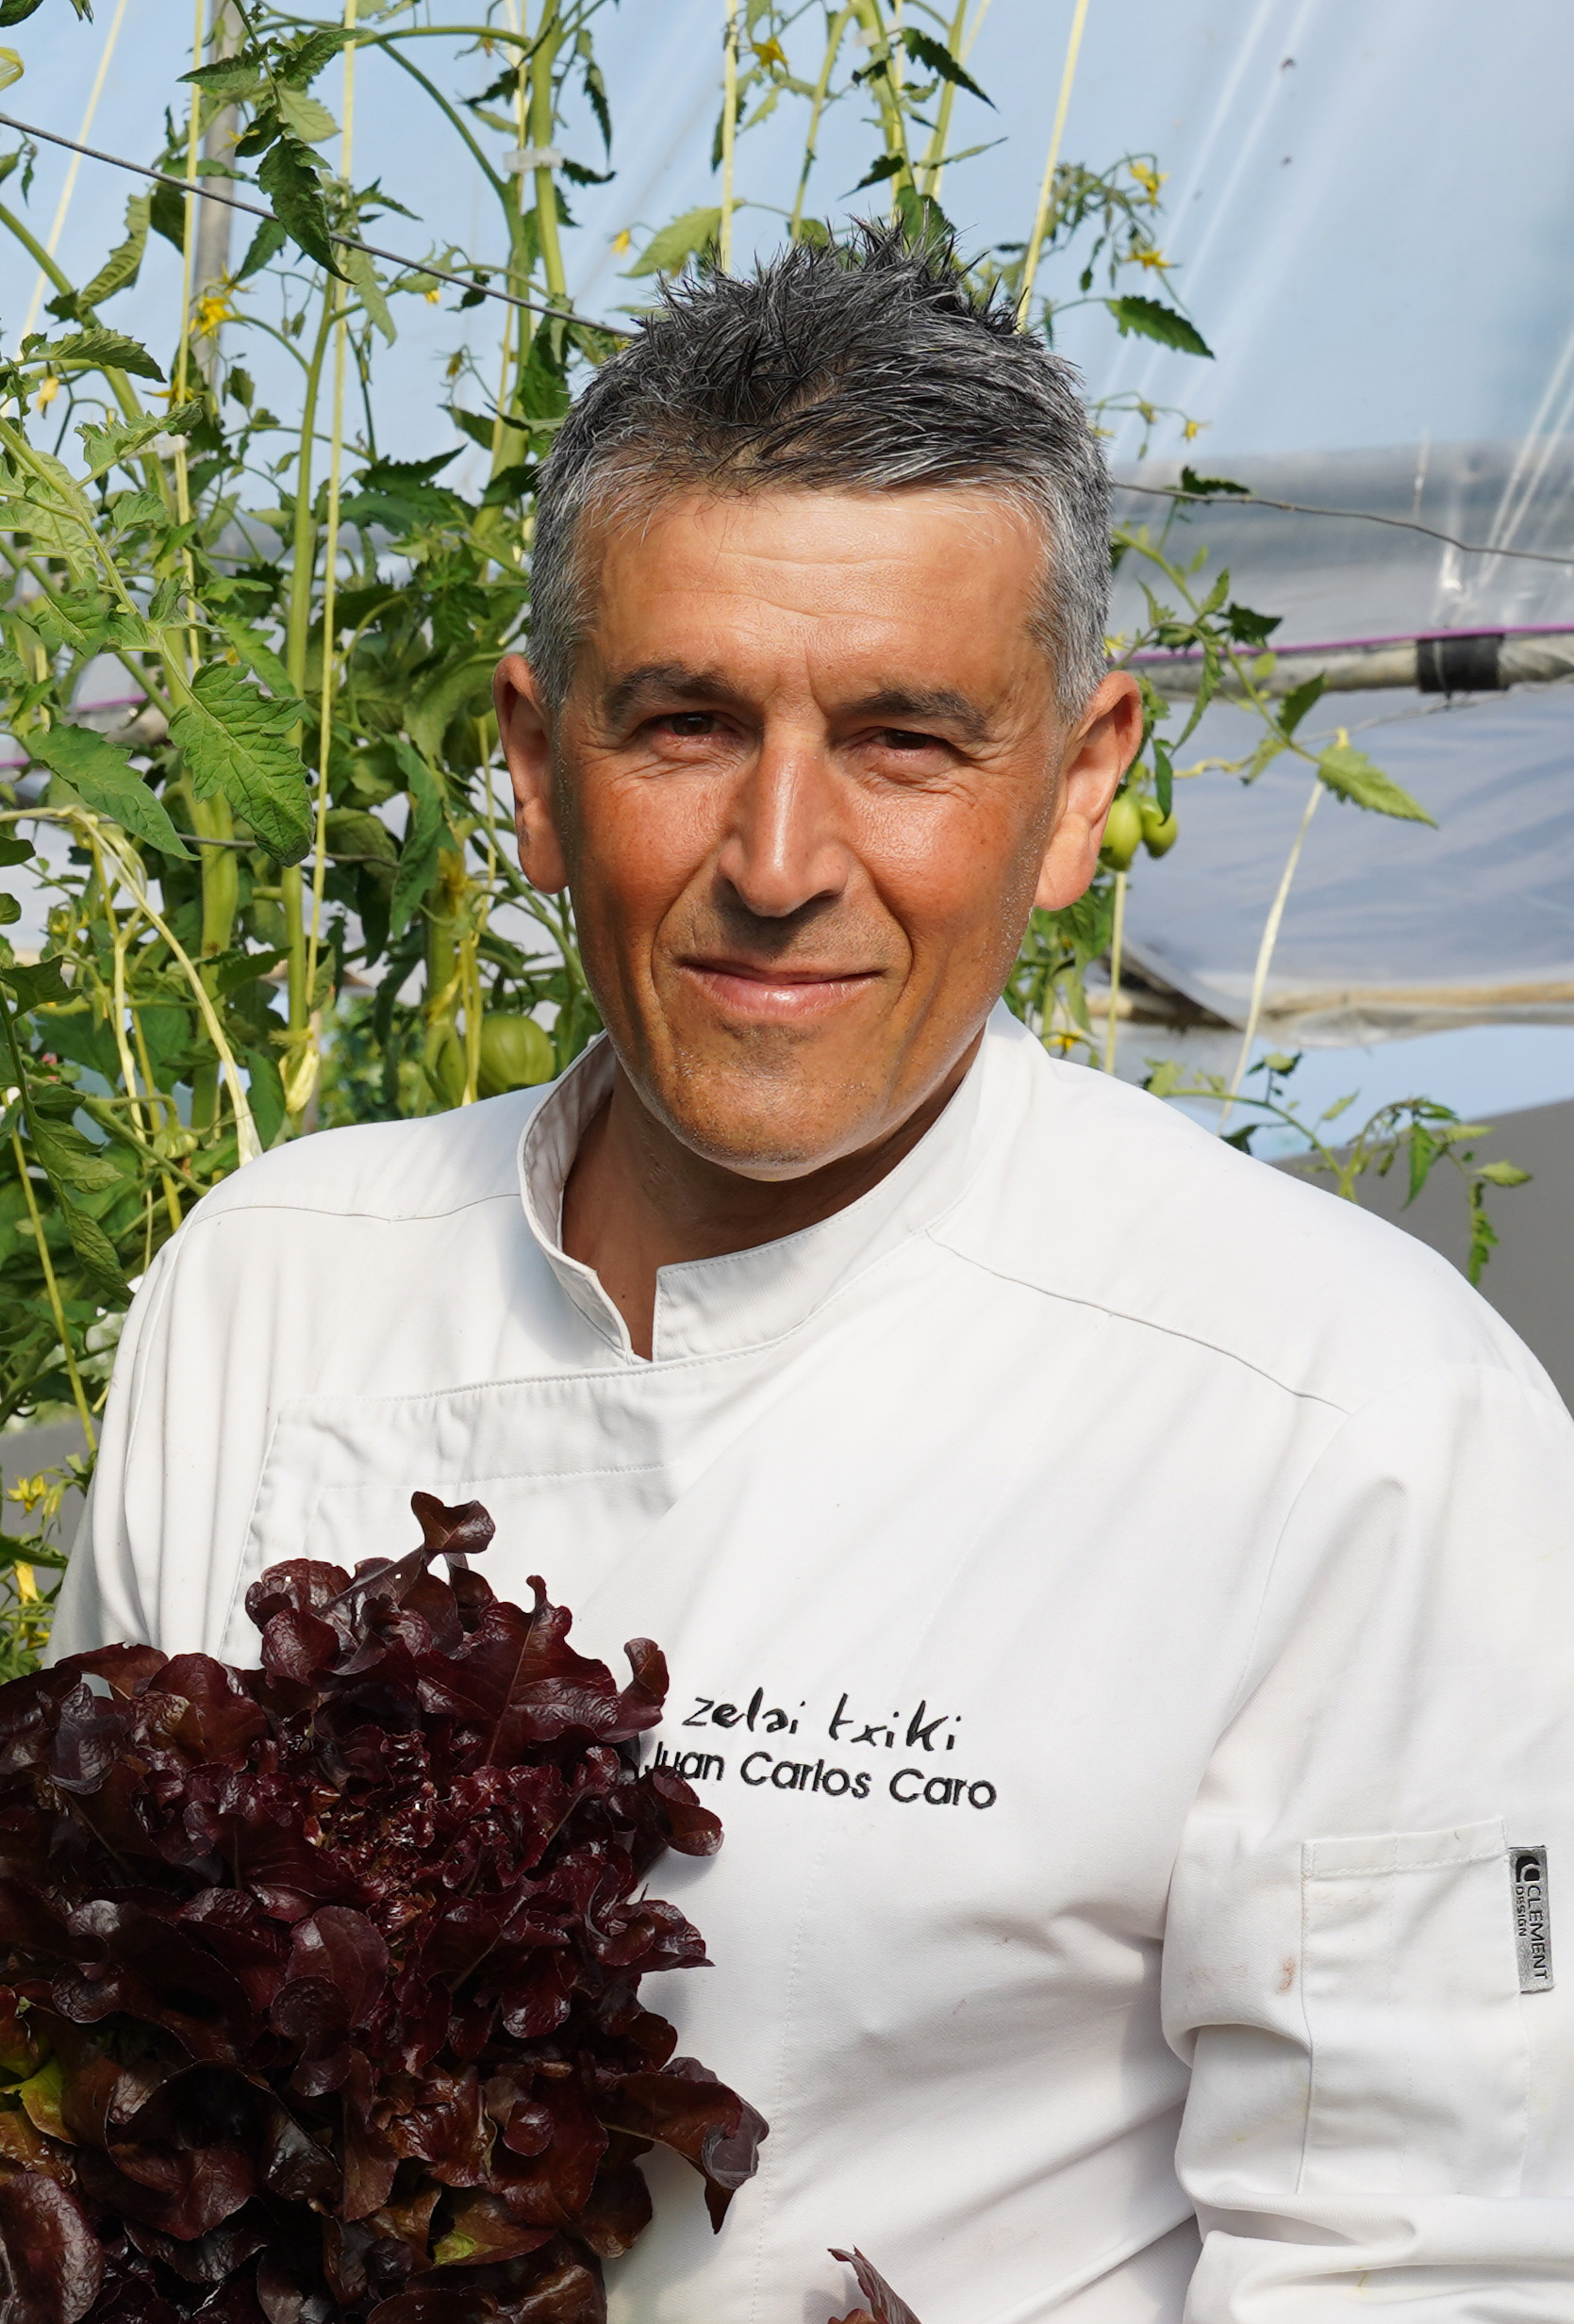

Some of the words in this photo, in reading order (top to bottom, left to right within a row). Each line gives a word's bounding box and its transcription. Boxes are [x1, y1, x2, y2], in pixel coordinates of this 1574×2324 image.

[681, 1687, 806, 1733] zelai
[739, 1751, 870, 1800] Carlos
[888, 1767, 997, 1809] Caro
[1516, 1887, 1528, 1937] DESIGN
[1527, 1886, 1549, 1980] CLEMENT
